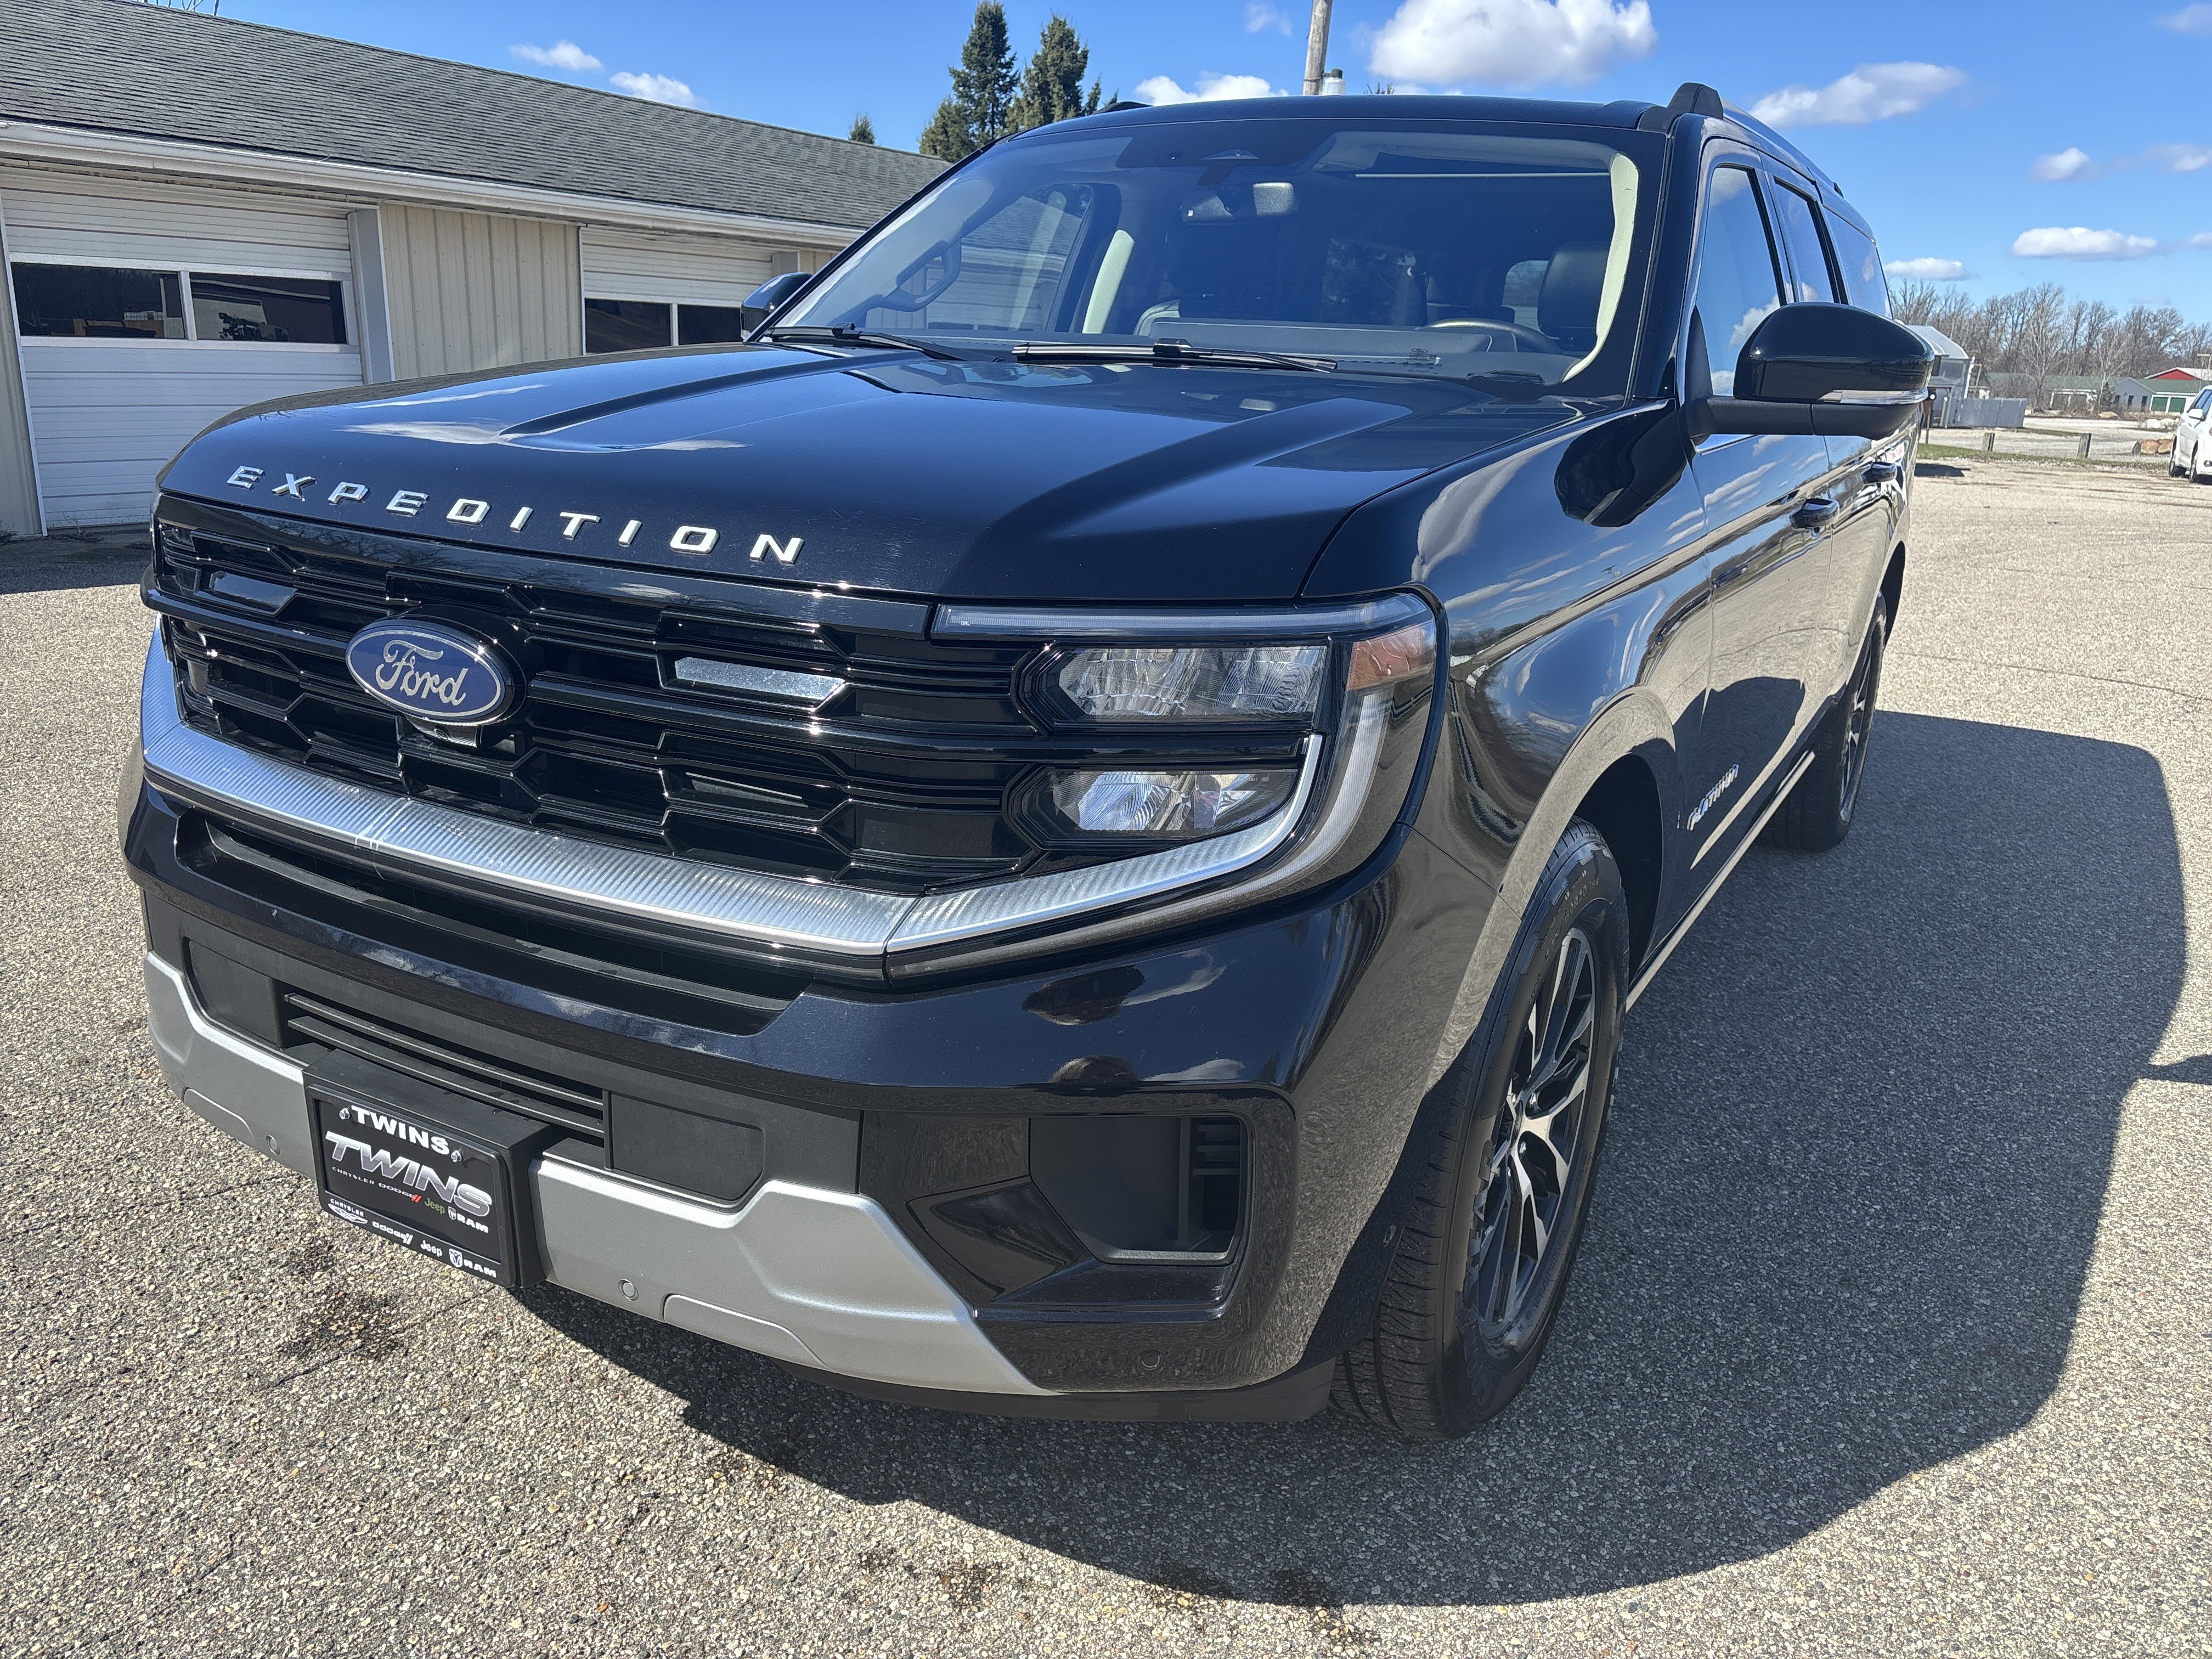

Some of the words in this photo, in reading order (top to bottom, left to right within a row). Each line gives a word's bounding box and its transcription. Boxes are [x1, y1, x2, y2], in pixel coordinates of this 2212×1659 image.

[227, 465, 805, 565] EXPEDITION
[375, 639, 469, 706] Ford
[351, 1105, 450, 1155] TWINS
[325, 1131, 493, 1217] TWINS
[331, 1166, 375, 1186] CHRYSLER
[378, 1182, 417, 1201] DODGE
[424, 1197, 446, 1215] Jeep
[456, 1214, 489, 1233] RAM
[330, 1198, 365, 1217] CHRYSLER
[420, 1239, 443, 1257] Jeep
[464, 1259, 497, 1278] RAM
